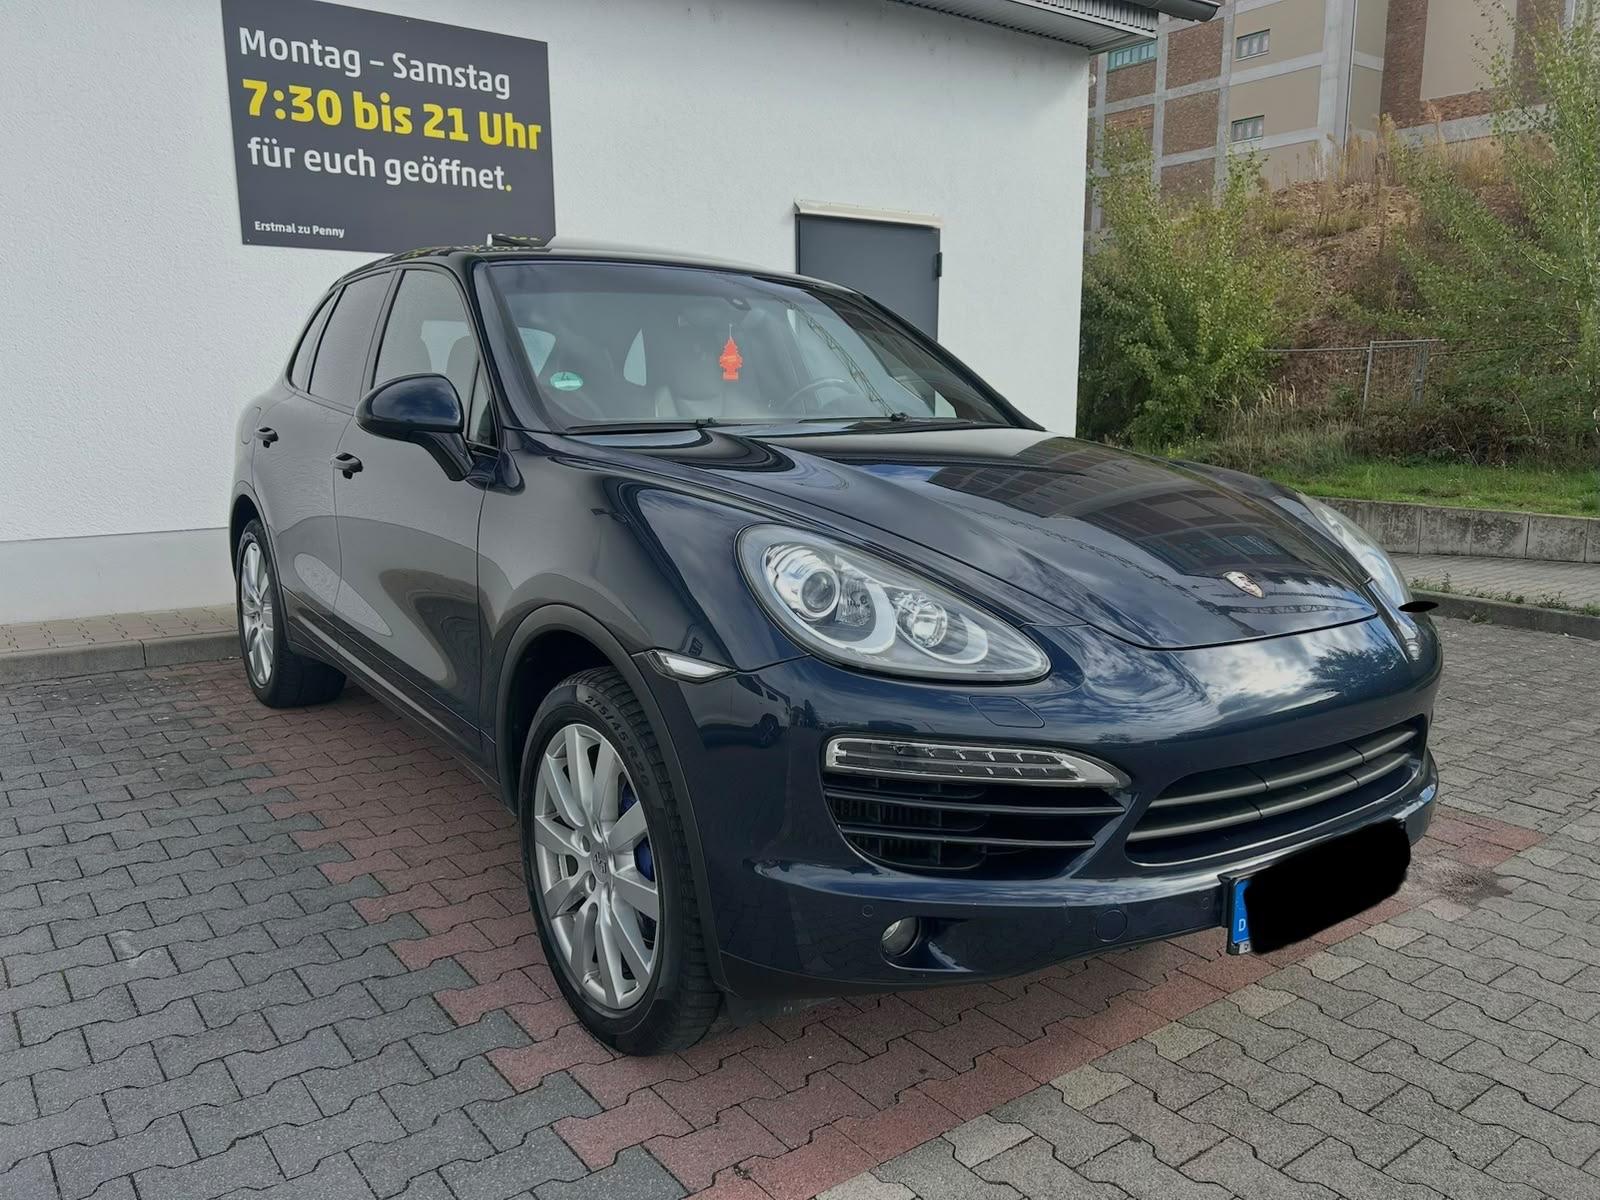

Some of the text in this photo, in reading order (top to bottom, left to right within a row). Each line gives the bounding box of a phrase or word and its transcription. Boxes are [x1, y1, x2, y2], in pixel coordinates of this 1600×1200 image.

[239, 27, 361, 78] Montag
[392, 52, 510, 100] Samstag
[242, 79, 542, 150] 7:30 bis 21 Uhr
[247, 137, 512, 192] für euch geöffnet.
[255, 221, 345, 238] Erstmal zu Penny
[1238, 918, 1246, 931] D
